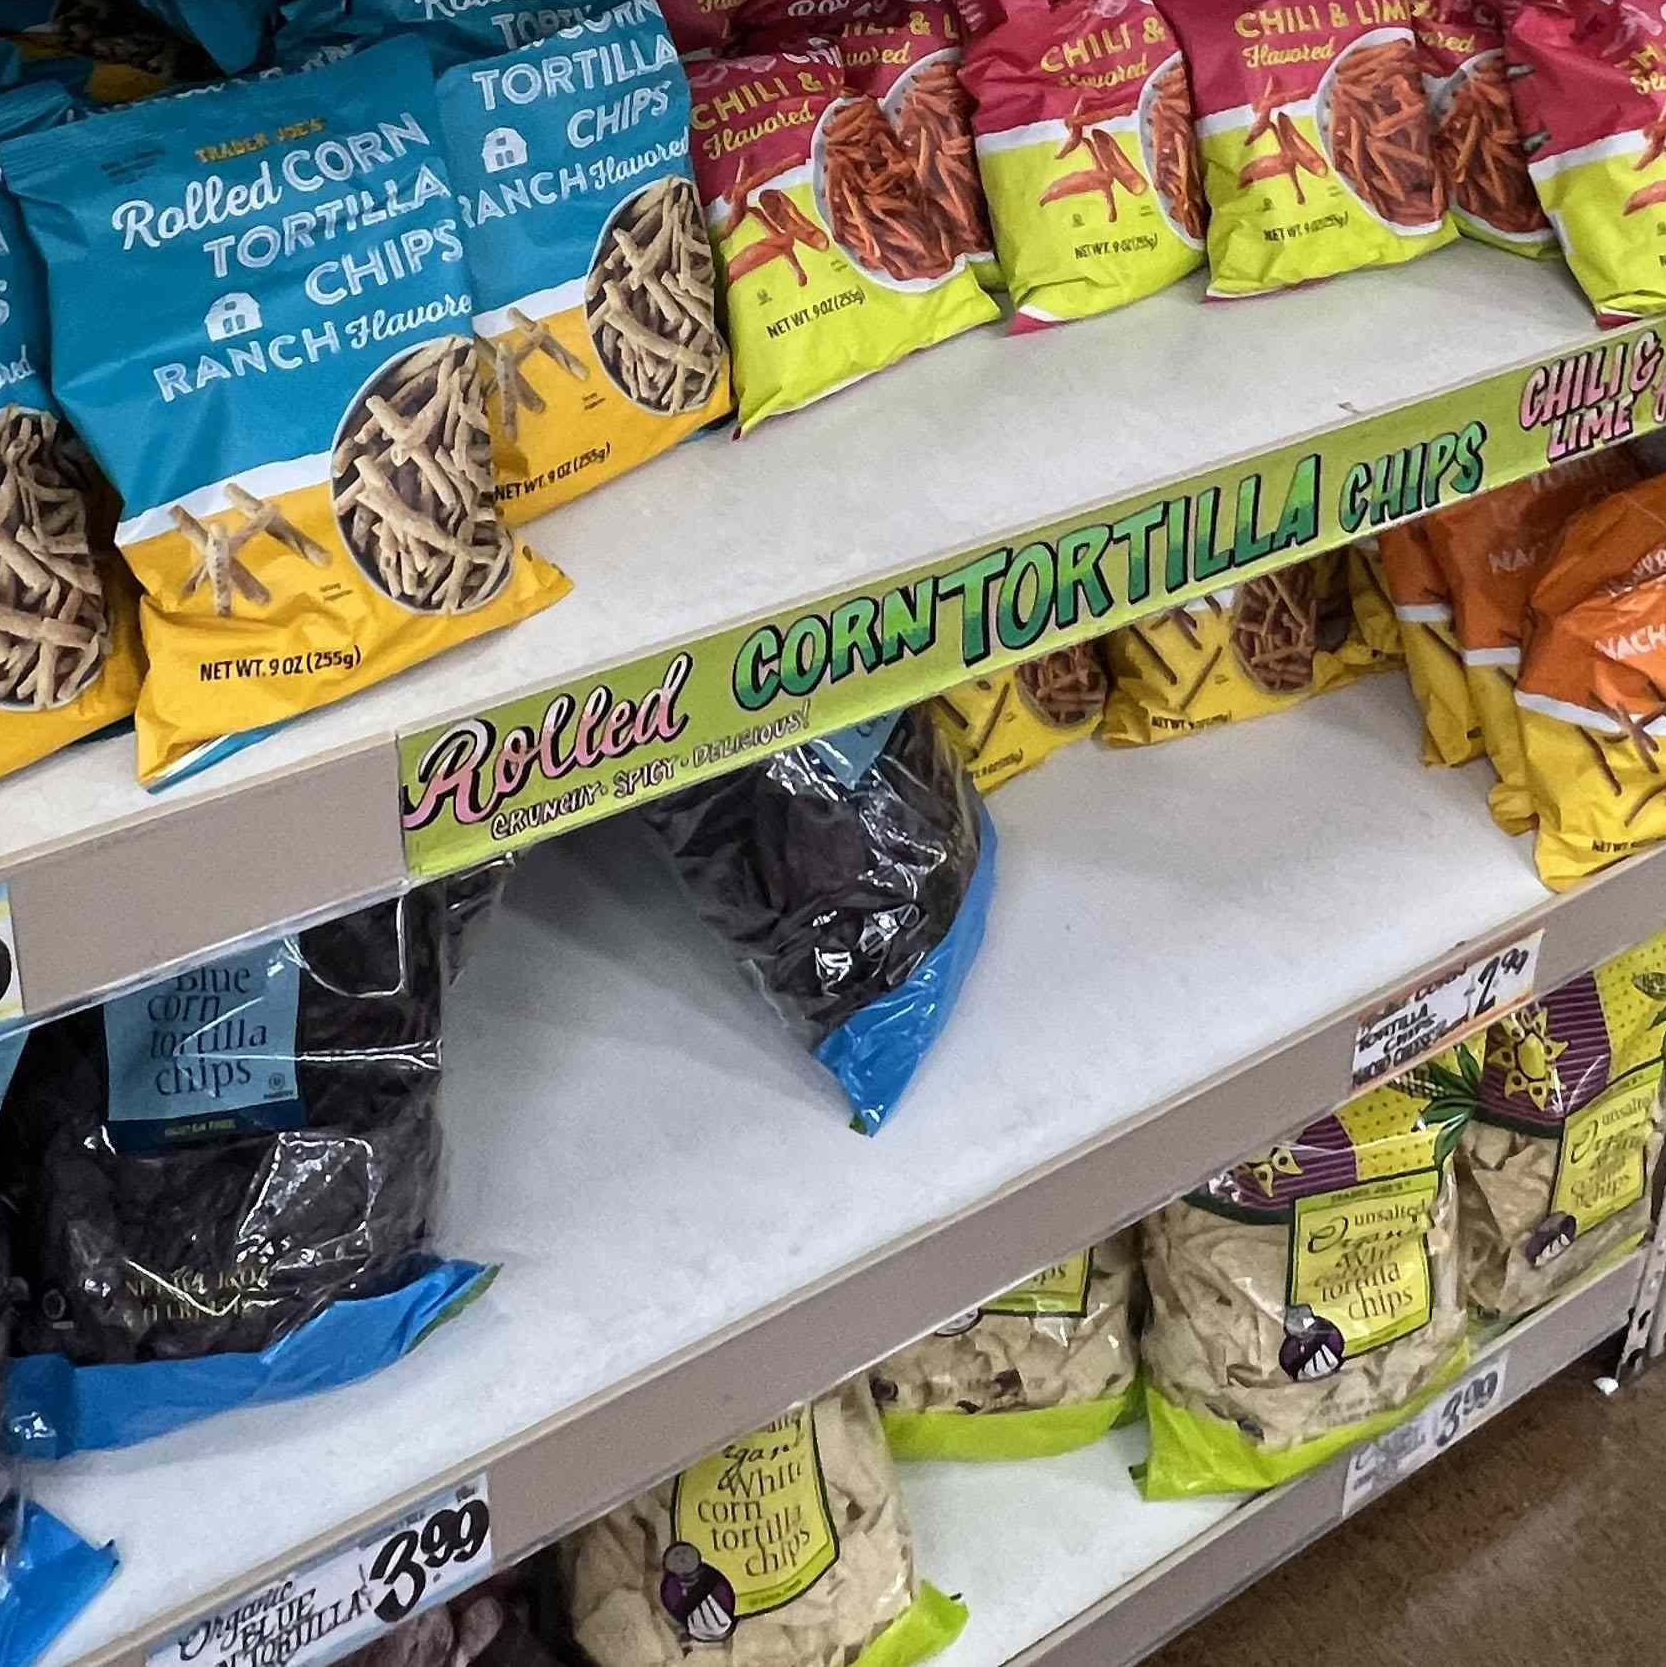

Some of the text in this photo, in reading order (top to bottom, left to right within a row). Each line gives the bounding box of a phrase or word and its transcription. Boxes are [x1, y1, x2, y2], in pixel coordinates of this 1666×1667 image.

[1039, 16, 1166, 73] CHILI &
[1234, 2, 1350, 38] CHILI &
[472, 32, 679, 112] TORTILLA
[1242, 36, 1337, 69] Flavored
[565, 81, 673, 150] CHIPS
[689, 71, 823, 131] CHILI &
[702, 99, 815, 161] Flavored
[193, 133, 270, 166] TRADER
[589, 132, 691, 194] Flavored
[111, 112, 434, 251] Rolled CORN
[203, 163, 453, 280] TORTILLA
[304, 219, 467, 307] CHIPS
[153, 290, 473, 405] RANCH Flavore
[767, 320, 791, 339] NET
[792, 313, 812, 333] WT.
[1519, 328, 1664, 431] CHILI &
[1547, 393, 1635, 465] LIME
[494, 482, 521, 502] NET
[521, 475, 544, 495] WT.
[556, 460, 574, 481] OZ
[575, 441, 612, 473] (255g)
[935, 419, 1488, 668] TORTILLA CHIPS
[199, 645, 363, 684] NET WT. 9 OZ (255g)
[404, 575, 941, 829] Rolled CORN
[490, 699, 813, 840] CRUNCHY SPICY DELICIOUS!
[146, 993, 222, 1023] corn
[174, 965, 251, 995] Blue
[149, 1019, 268, 1059] tortilla
[154, 1057, 252, 1099] chips
[1348, 1287, 1413, 1321] chips
[698, 1500, 763, 1524] corn
[745, 1528, 810, 1577] chips
[178, 1580, 294, 1661] Organic
[241, 1587, 317, 1648] BLUE
